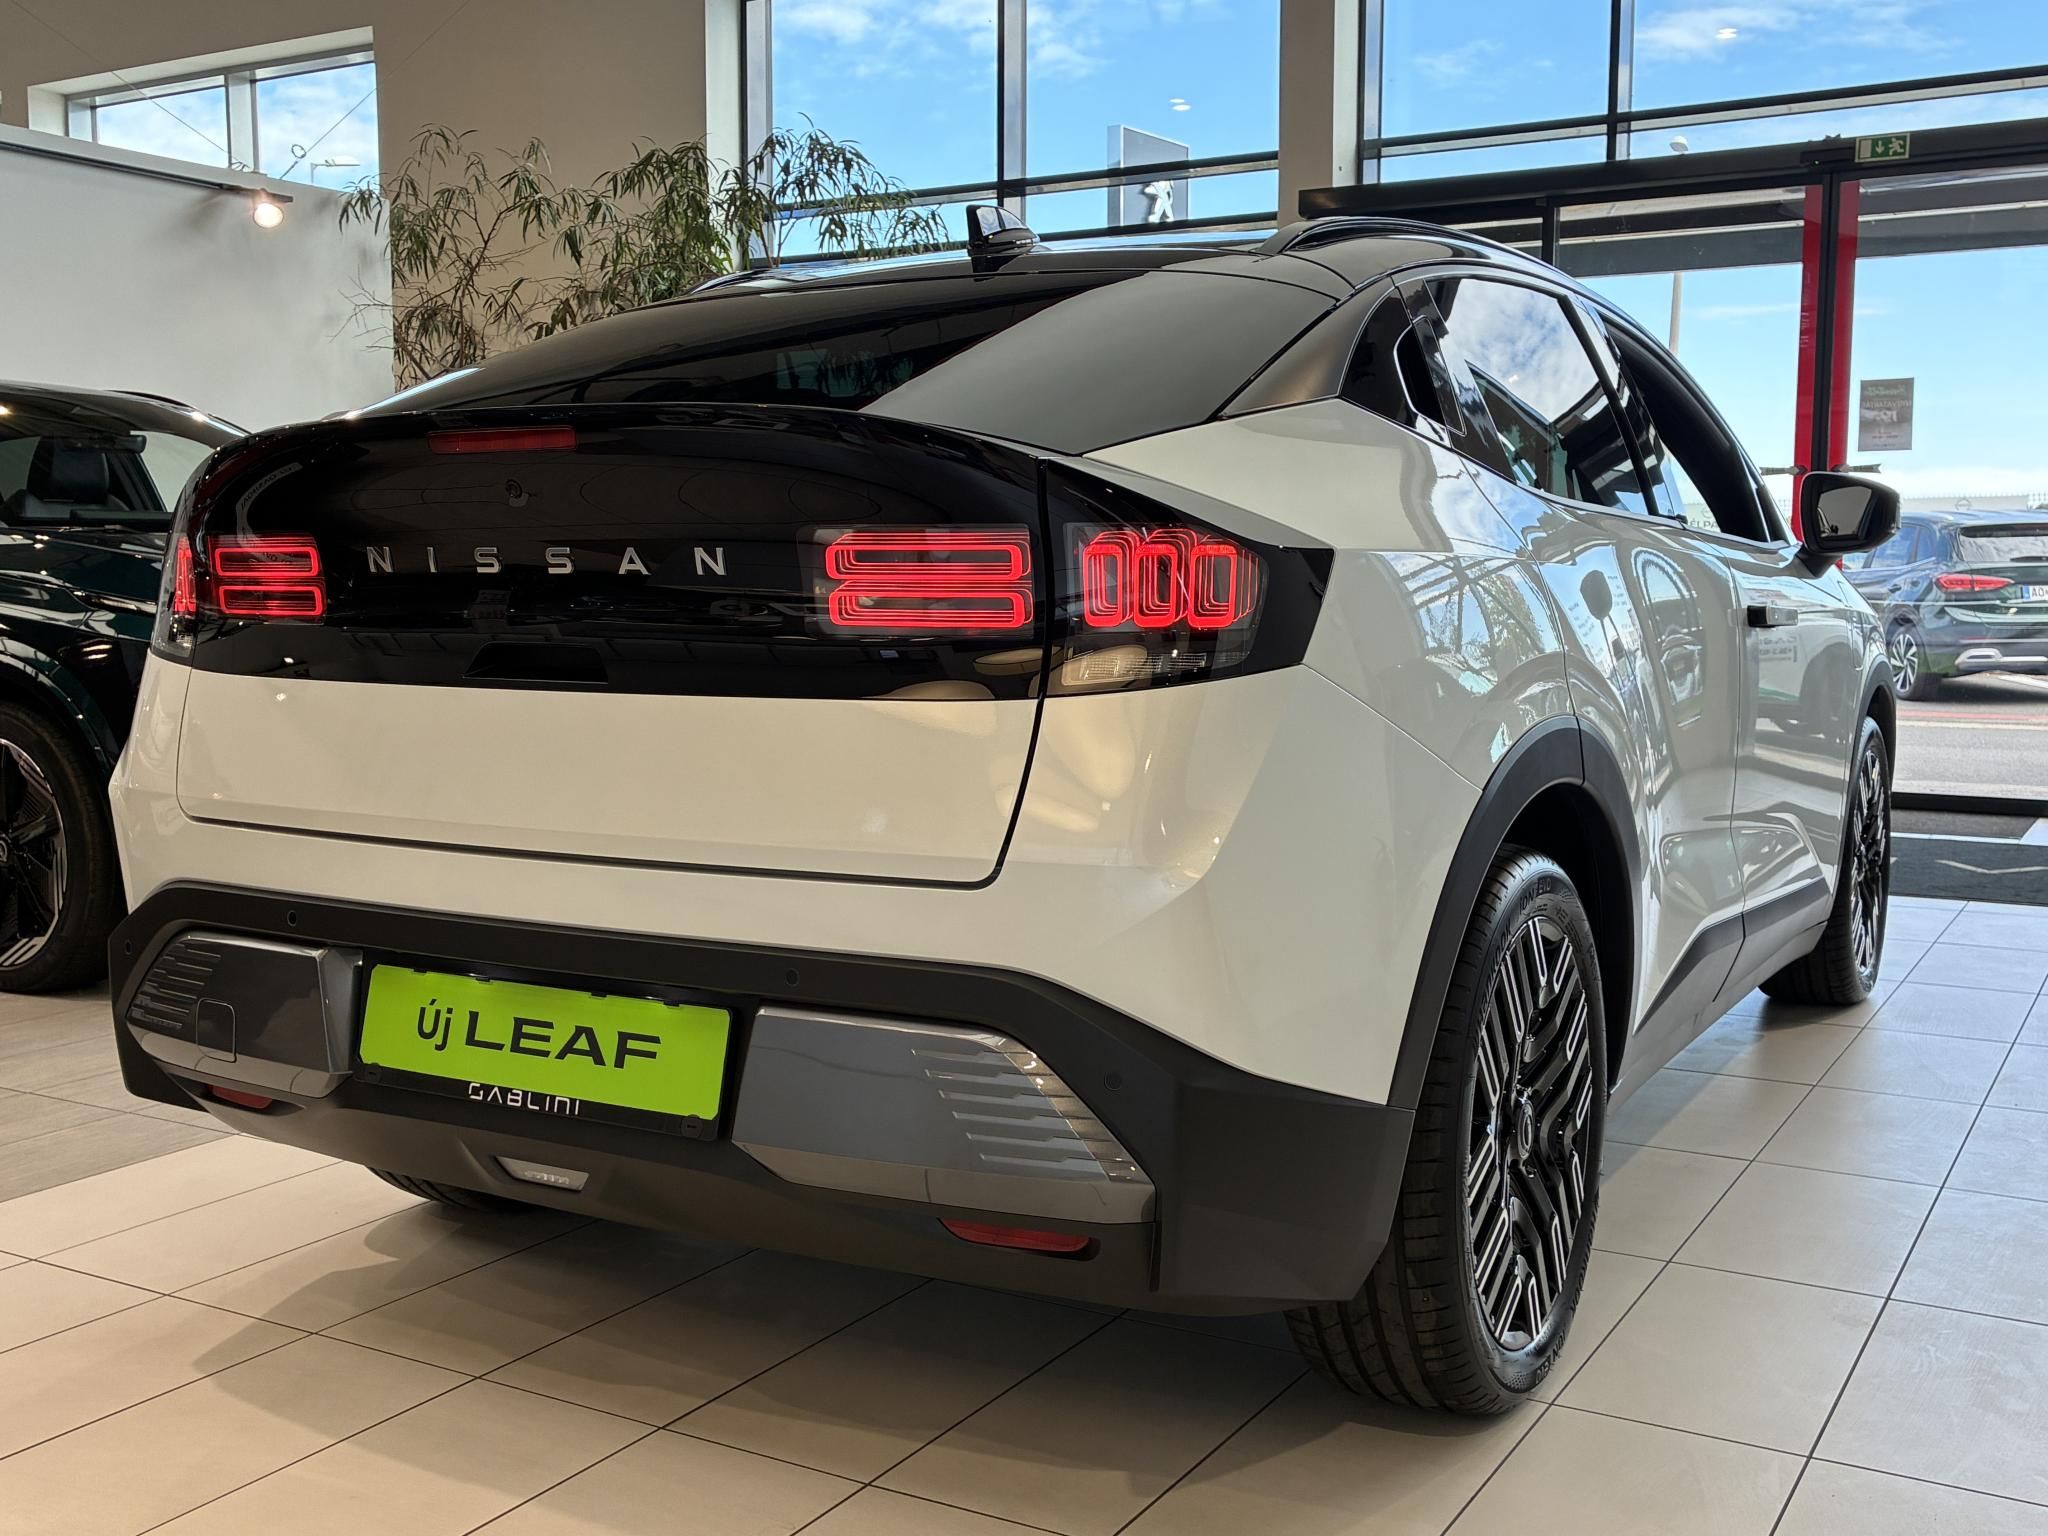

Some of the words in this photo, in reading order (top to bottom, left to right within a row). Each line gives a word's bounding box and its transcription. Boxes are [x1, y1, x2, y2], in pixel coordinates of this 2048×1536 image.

[366, 546, 726, 576] NISSAN
[417, 998, 453, 1052] Új
[465, 1010, 662, 1069] LEAF
[468, 1082, 580, 1116] GABLINI
